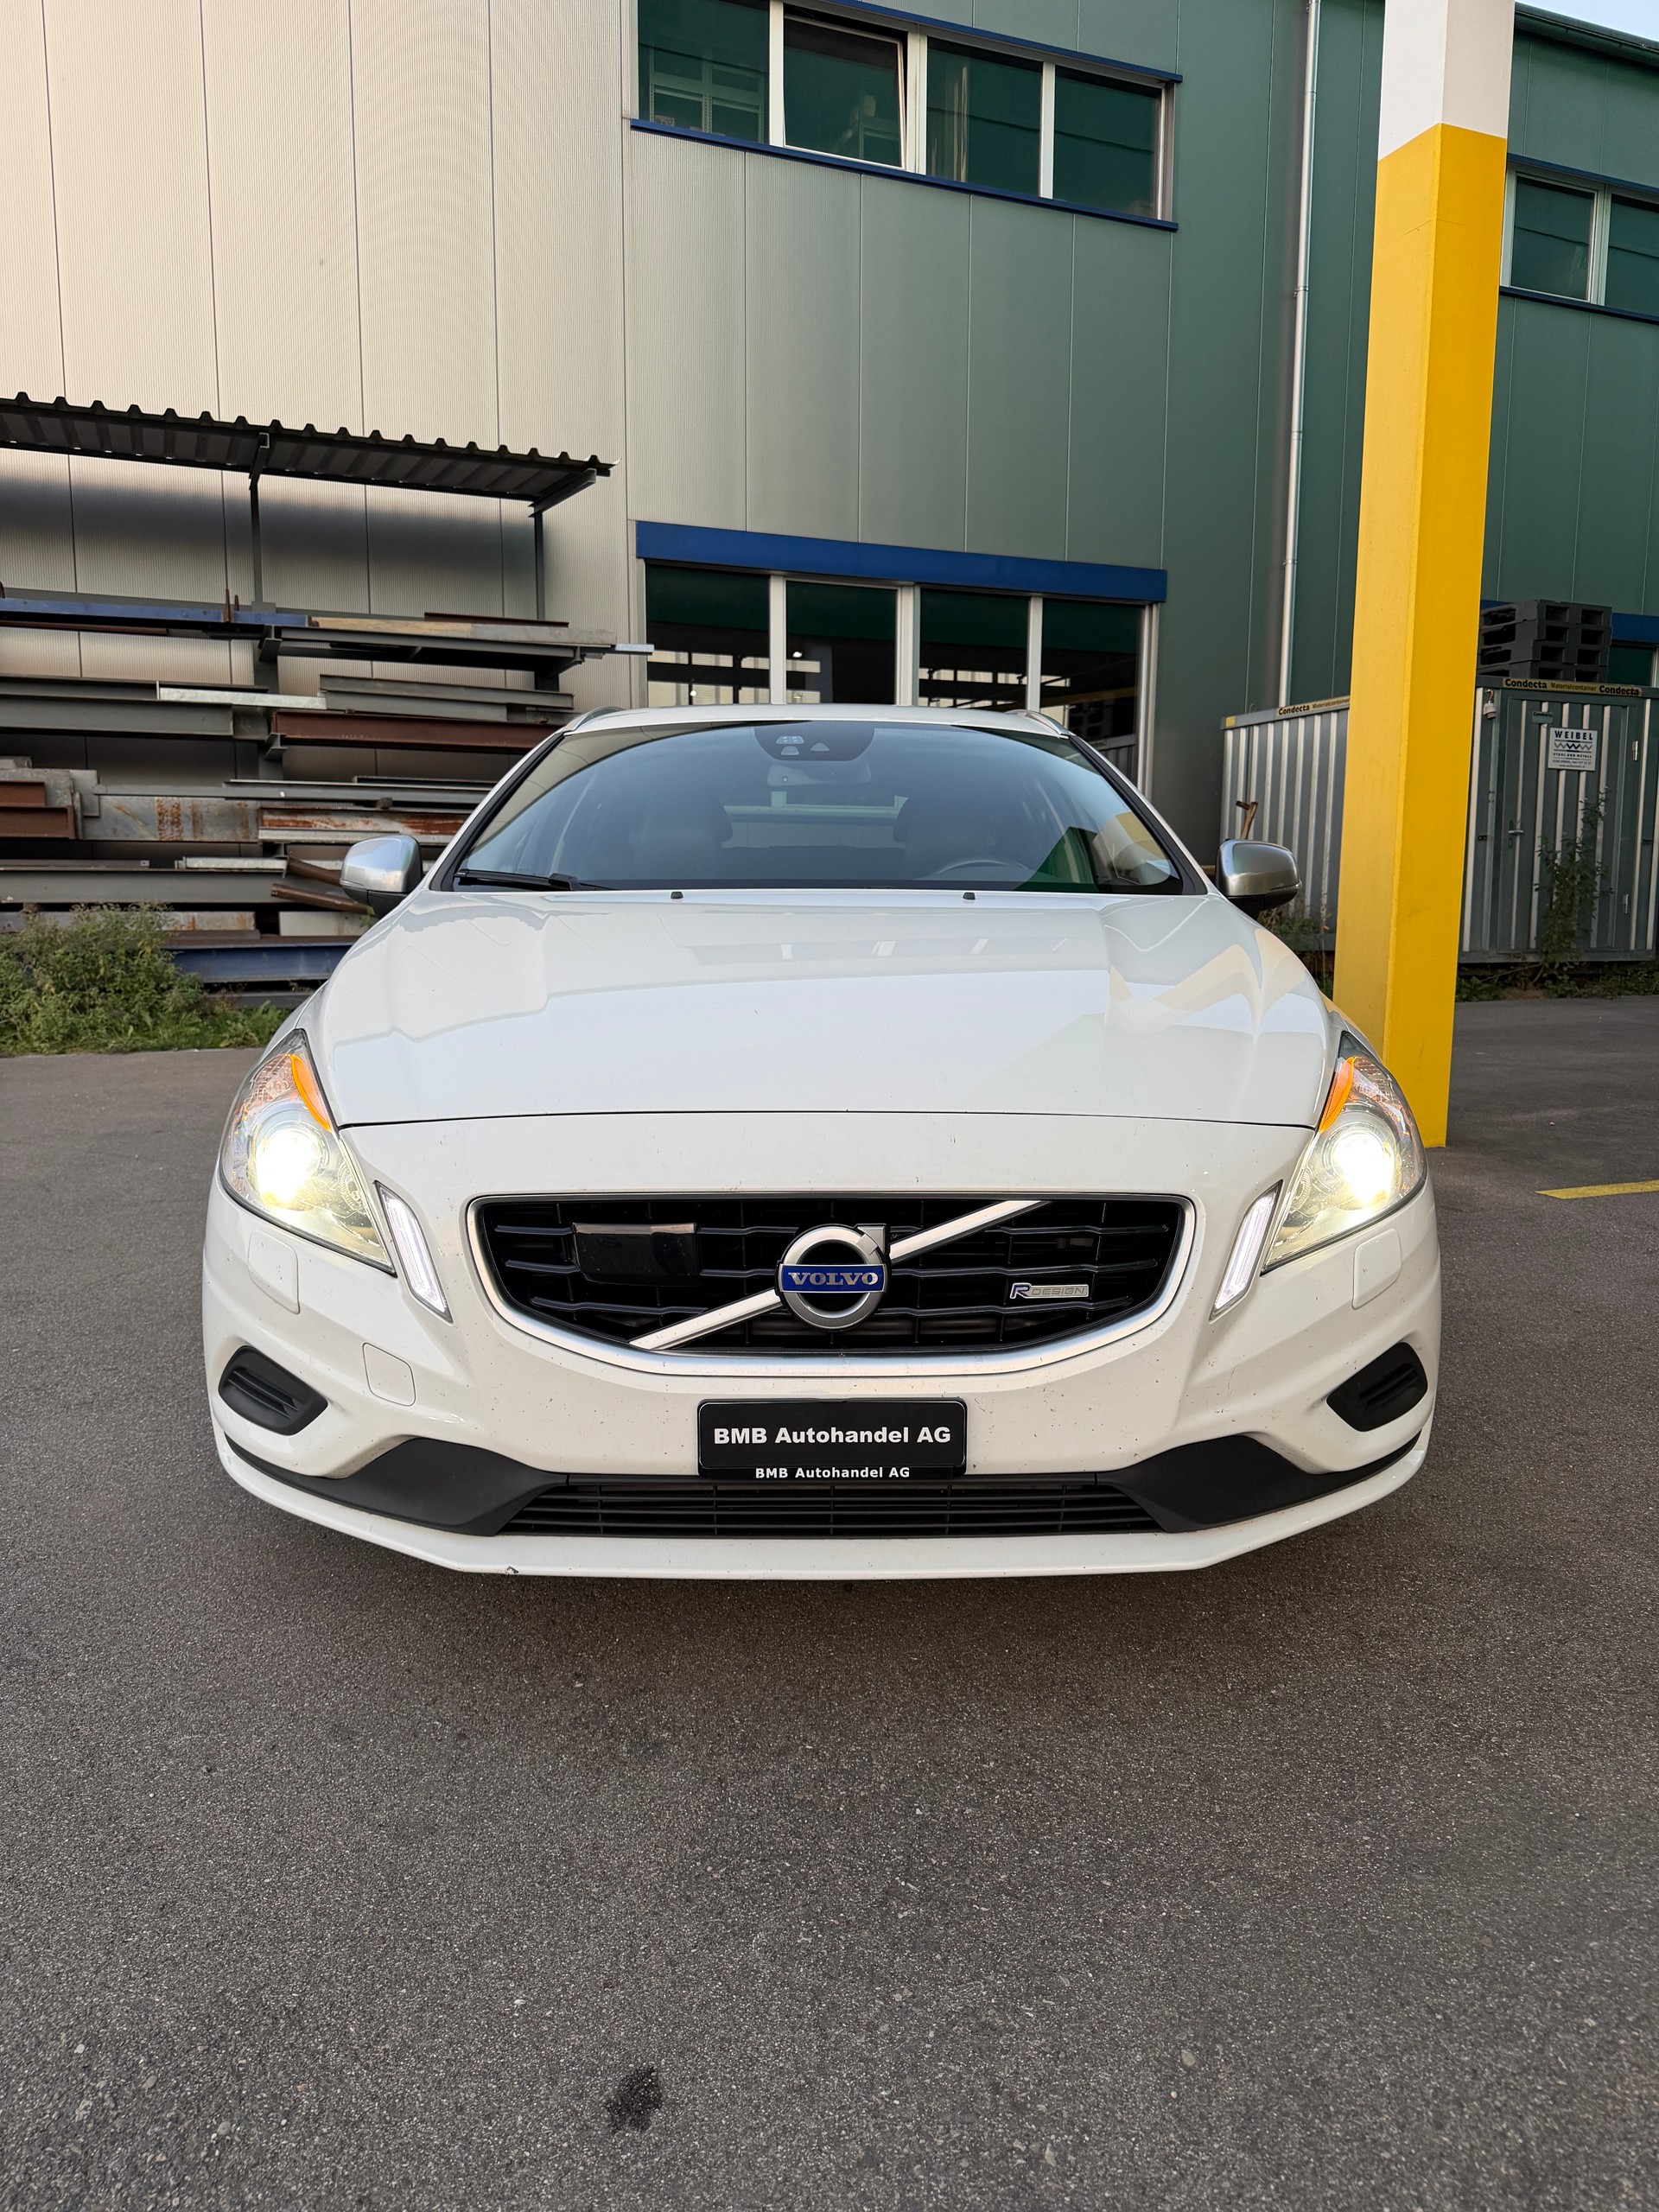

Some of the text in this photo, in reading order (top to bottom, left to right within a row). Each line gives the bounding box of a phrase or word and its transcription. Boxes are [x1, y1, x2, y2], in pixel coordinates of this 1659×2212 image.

[1504, 678, 1640, 696] Condecta Materialcontainer Condecta
[1279, 704, 1310, 715] Condecta
[1554, 730, 1592, 741] WEIBEL
[788, 1272, 879, 1286] VOLVO
[714, 1427, 951, 1444] BMB Autohandel AG
[755, 1467, 910, 1478] BMB Autohandel AG
